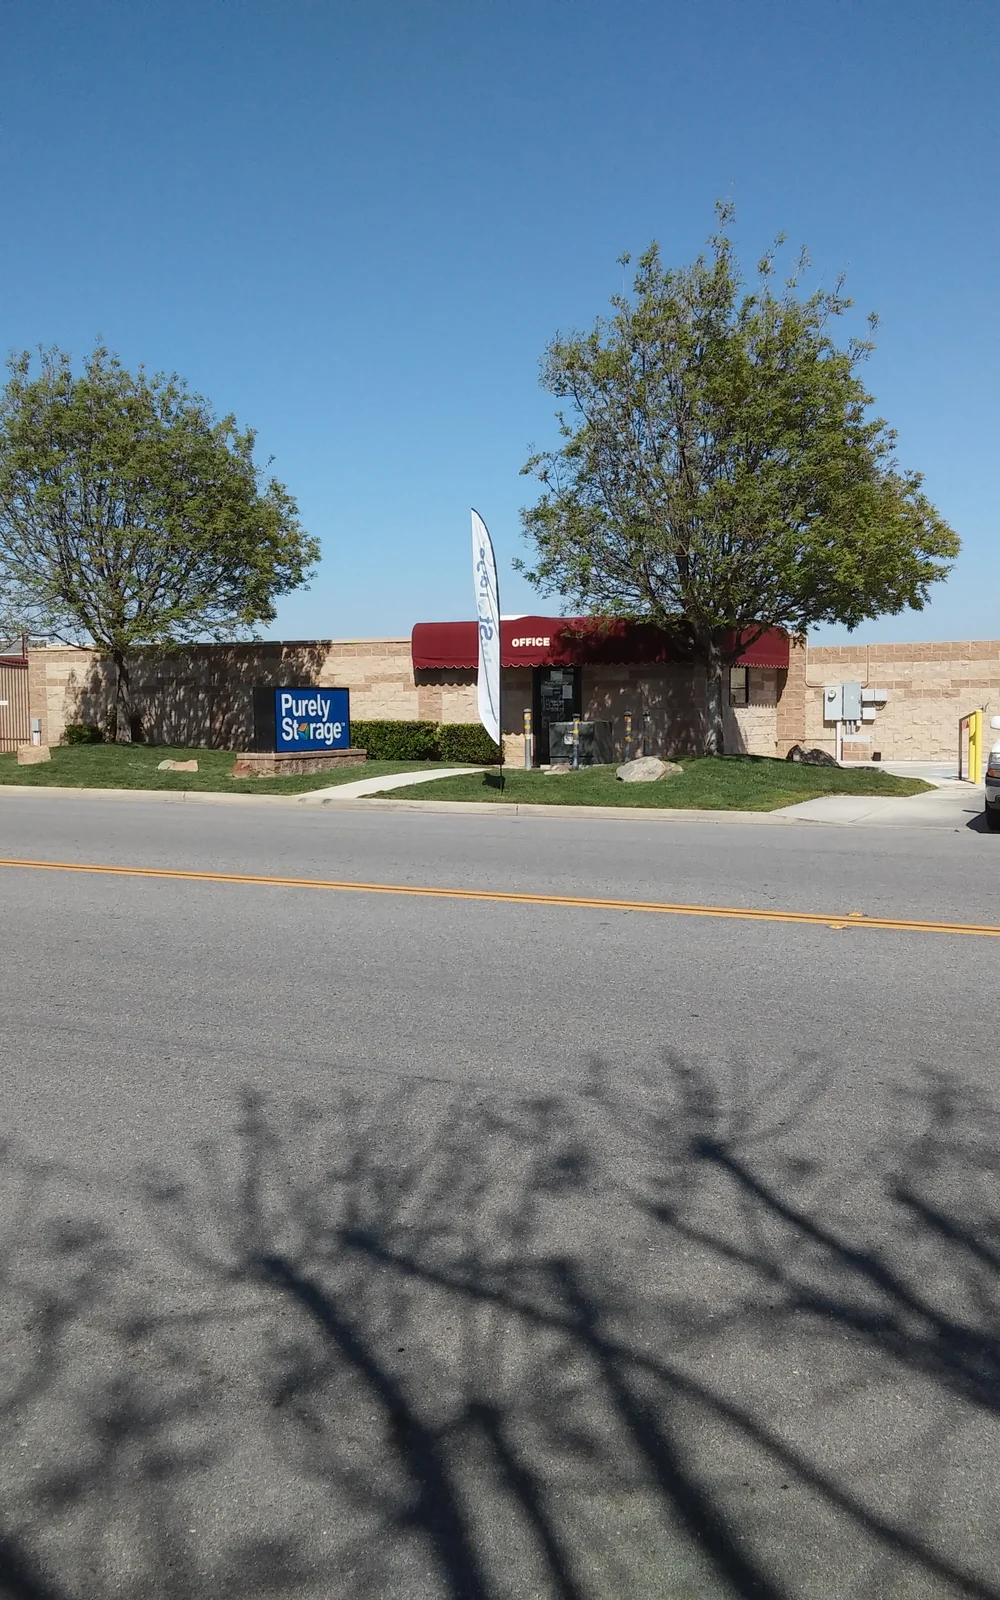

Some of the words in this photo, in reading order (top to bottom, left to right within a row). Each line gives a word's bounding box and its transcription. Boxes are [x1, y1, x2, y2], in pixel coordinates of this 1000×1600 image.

[511, 637, 550, 647] OFFICE
[281, 693, 330, 722] Purely
[282, 717, 342, 745] Storage
